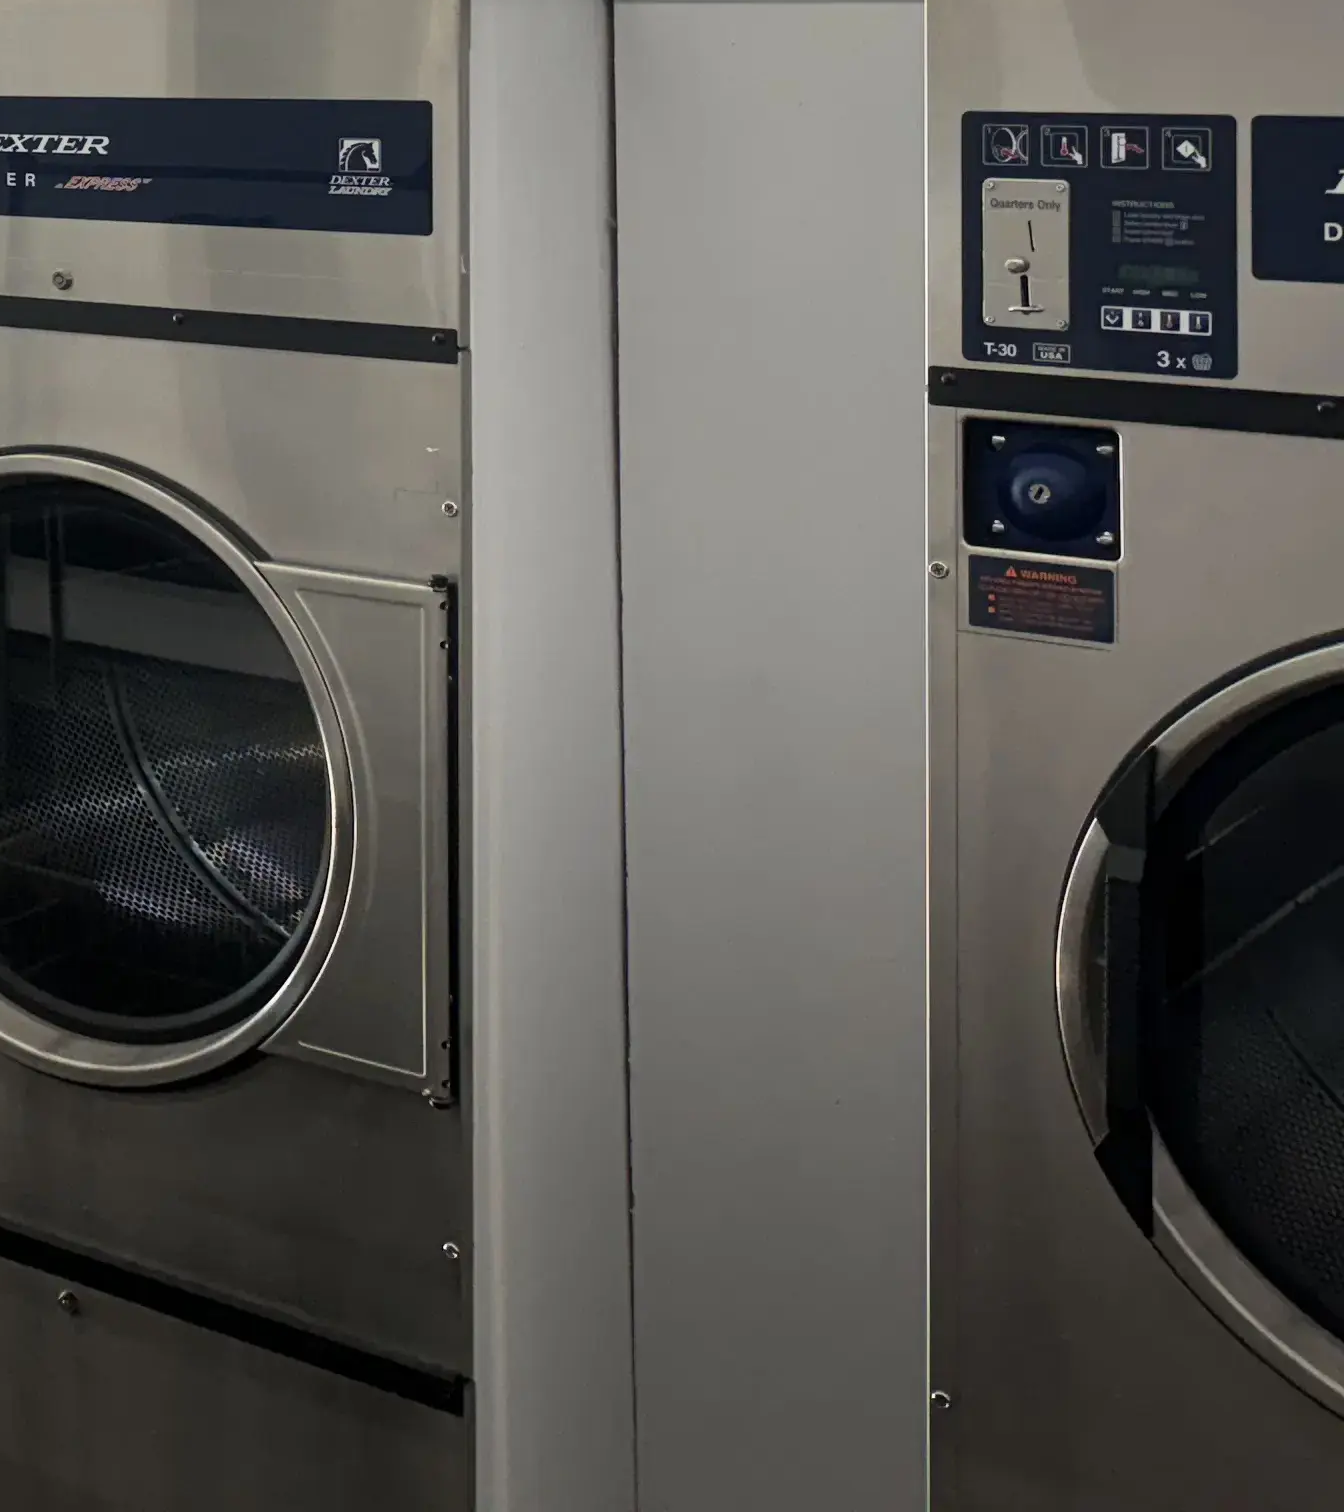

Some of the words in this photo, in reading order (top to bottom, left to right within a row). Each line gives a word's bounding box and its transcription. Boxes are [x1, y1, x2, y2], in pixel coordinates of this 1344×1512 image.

[63, 175, 141, 192] EXPRESS
[329, 175, 390, 186] DEXTER
[328, 186, 393, 196] LAUNDRY
[989, 198, 1034, 210] Quarters
[1037, 199, 1062, 212] Only
[983, 342, 1017, 358] T-30
[1040, 351, 1063, 361] USA
[1156, 350, 1170, 369] 3
[1175, 357, 1187, 369] x
[1020, 569, 1077, 585] WARNING
